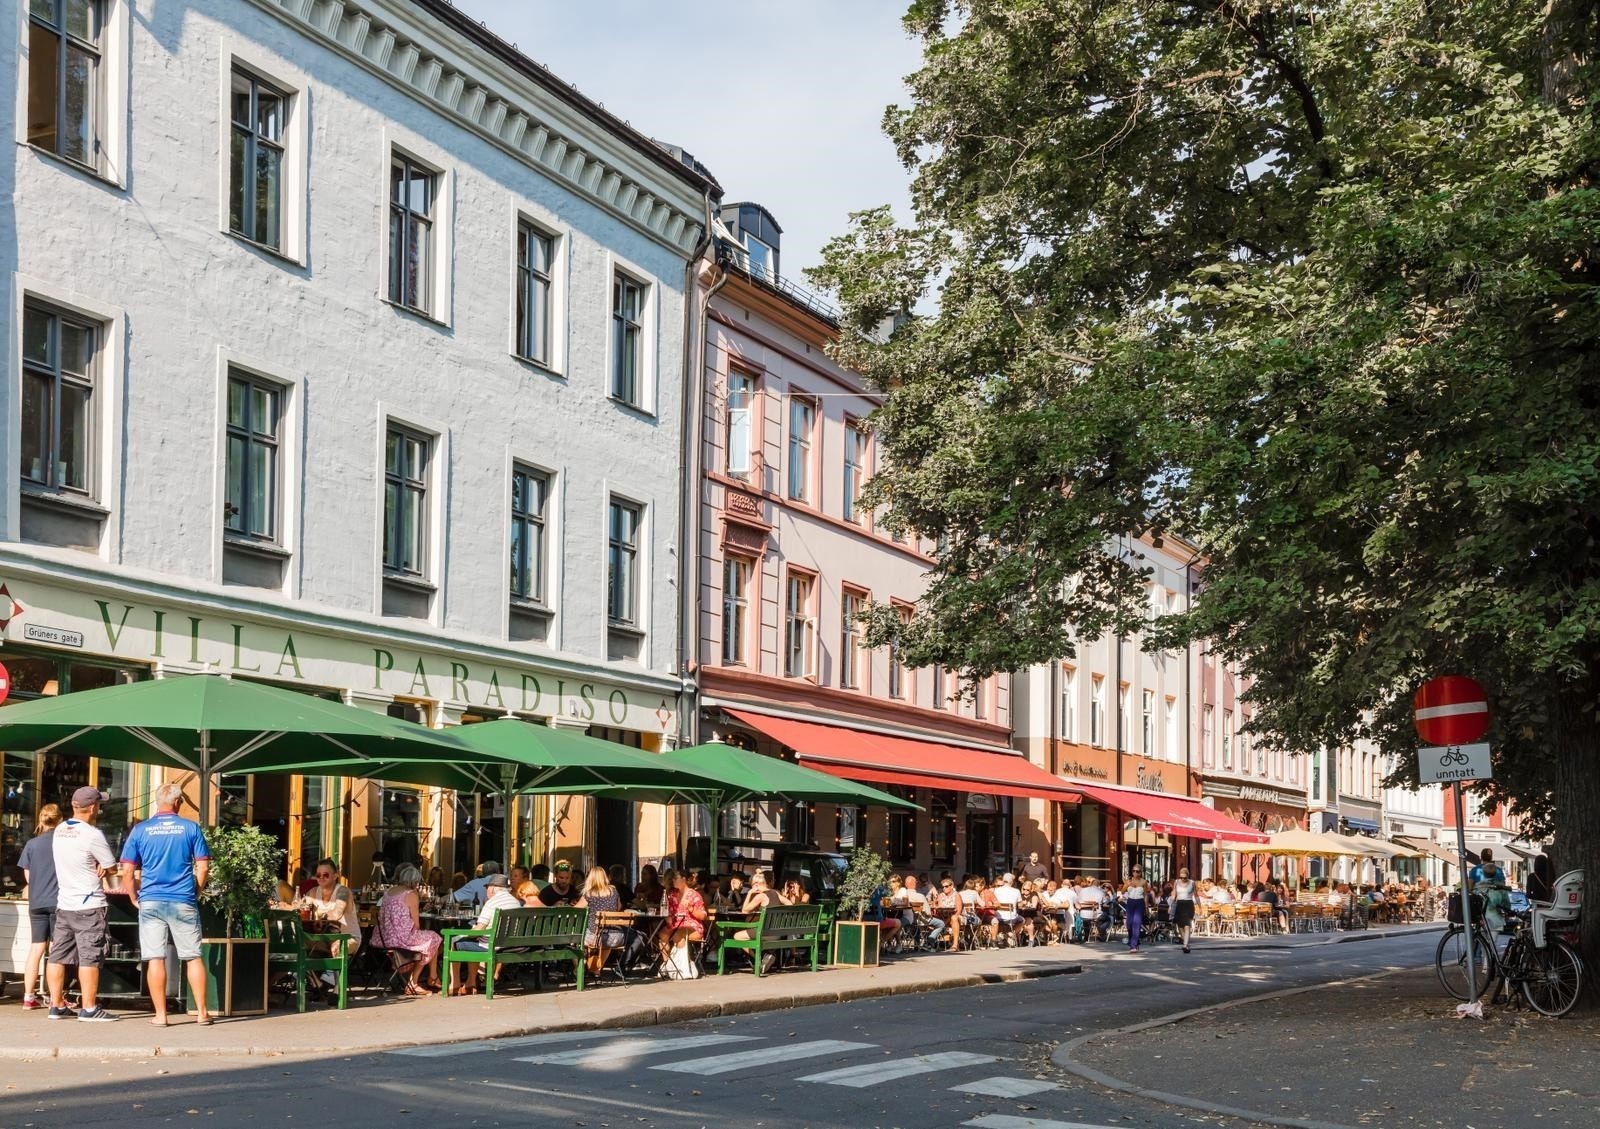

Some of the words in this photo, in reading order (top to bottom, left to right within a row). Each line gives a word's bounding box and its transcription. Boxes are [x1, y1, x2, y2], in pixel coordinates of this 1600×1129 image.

[29, 628, 58, 639] Grüners
[61, 634, 78, 644] gate
[94, 600, 304, 679] VILLA
[373, 649, 628, 725] PARADISO
[1436, 768, 1475, 779] unntatt
